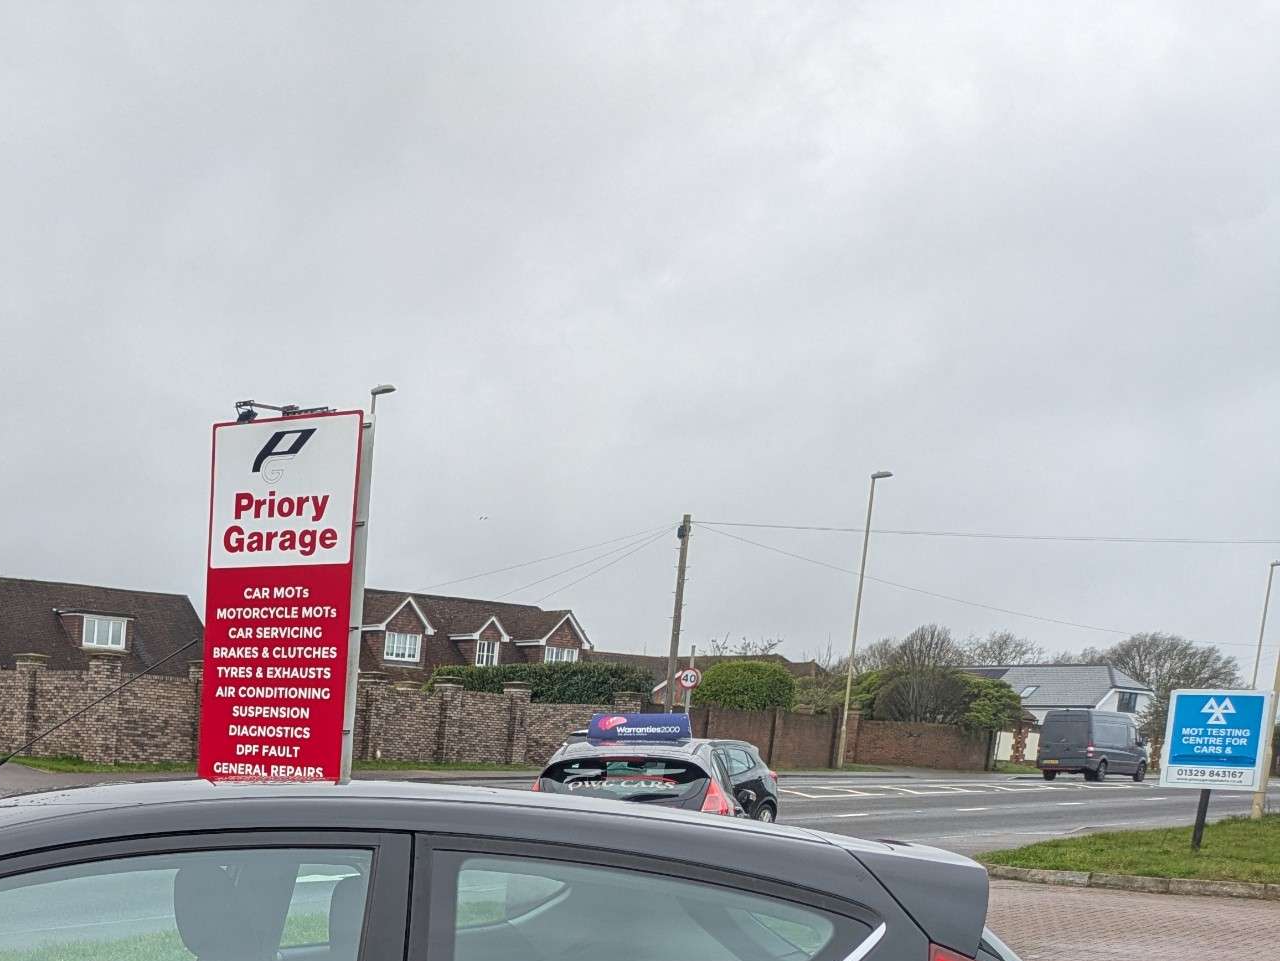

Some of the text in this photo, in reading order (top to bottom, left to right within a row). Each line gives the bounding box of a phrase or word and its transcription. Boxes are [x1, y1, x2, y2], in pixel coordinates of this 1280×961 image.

[235, 491, 330, 522] Priory
[223, 525, 338, 557] Garage
[243, 586, 310, 599] CAR MOTs
[216, 606, 337, 620] MOTORCYCLE MOTs
[228, 626, 322, 639] CAR SERVICING
[213, 646, 338, 659] BRAKES & CLUTCHES
[216, 666, 331, 679] TYRES & EXHAUSTS
[682, 673, 696, 683] 40
[215, 686, 331, 700] AIR CONDITIONING
[232, 705, 310, 719] SUSPENSION
[228, 725, 311, 739] DIAGNOSTICS
[616, 725, 681, 734] Warranties2000
[1181, 727, 1251, 737] MOT TESTING
[1182, 736, 1248, 746] CENTRE FOR
[236, 744, 300, 757] DPF FAULT
[1193, 745, 1222, 754] CARS
[213, 762, 324, 778] GENERAL REPAIRS
[1177, 768, 1206, 777] 01329
[620, 779, 676, 789] CARS
